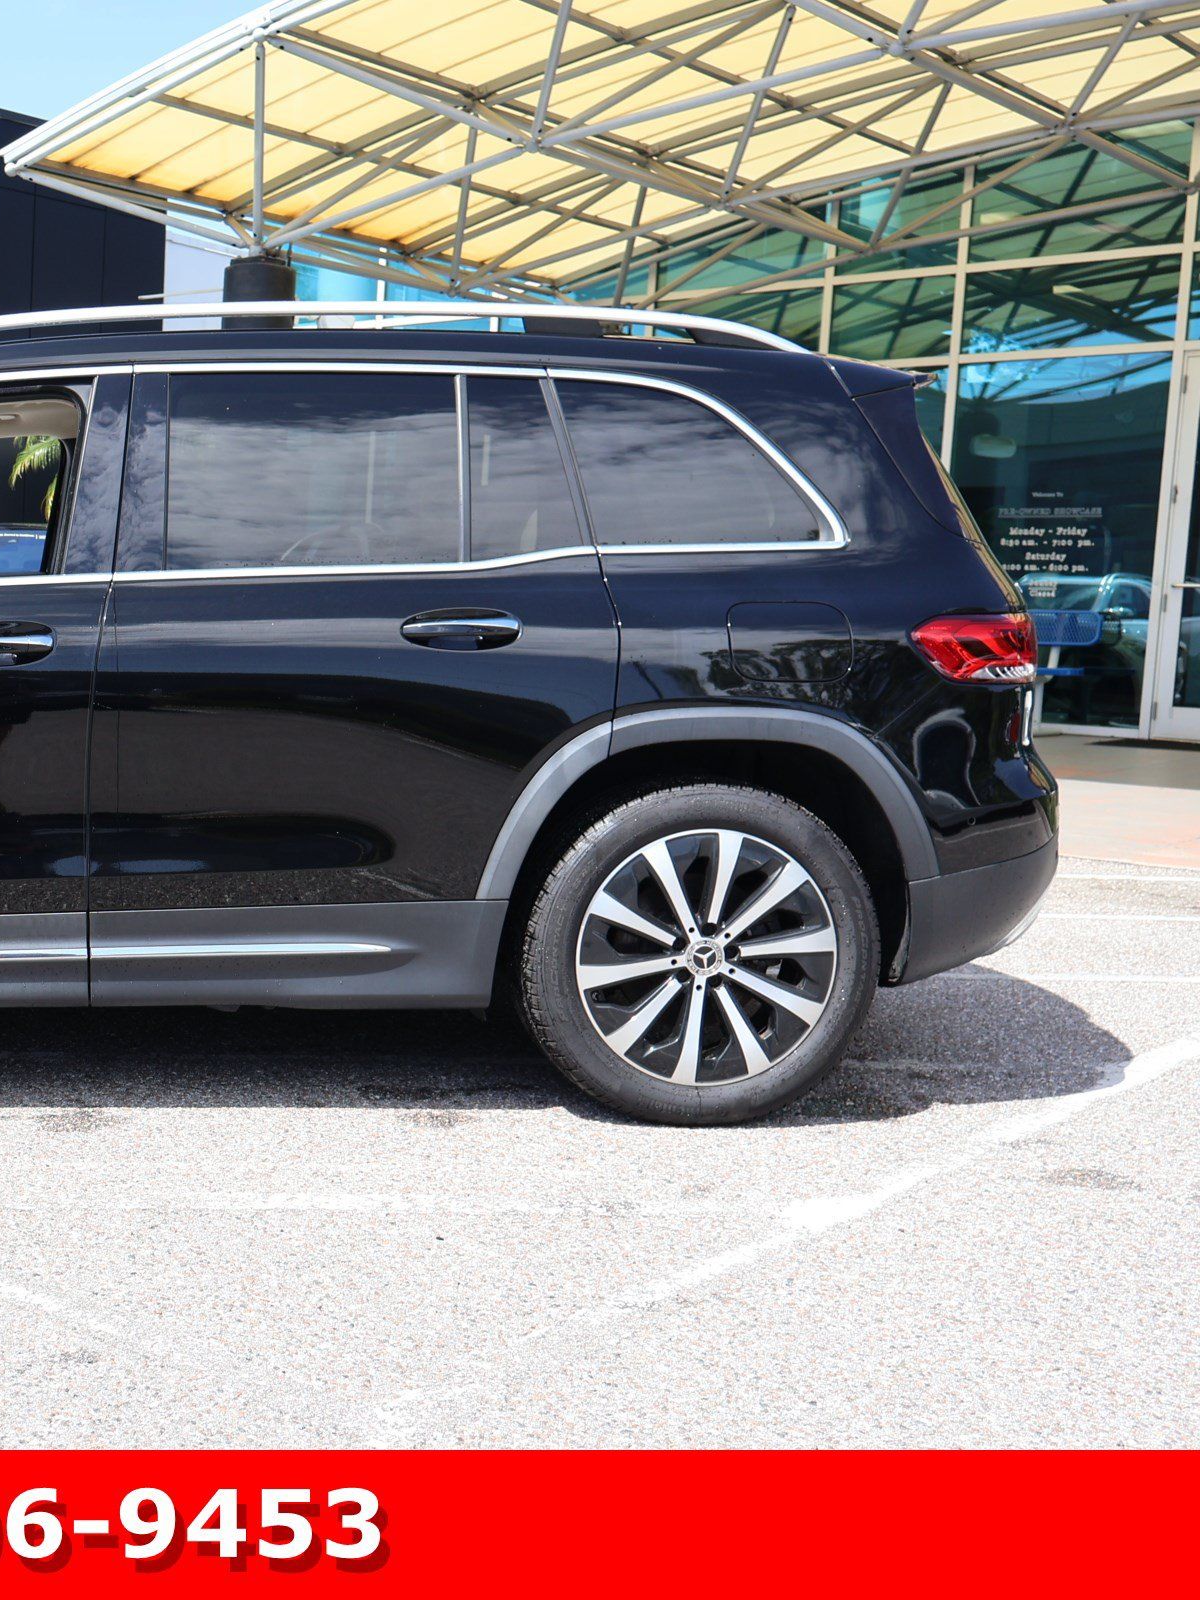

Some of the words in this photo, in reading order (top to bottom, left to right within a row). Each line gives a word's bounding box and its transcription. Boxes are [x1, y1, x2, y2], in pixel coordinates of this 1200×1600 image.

[1053, 507, 1103, 518] SHOWCASE
[1009, 527, 1045, 537] Monday
[1056, 527, 1088, 537] Friday
[1052, 539, 1073, 547] 7:00
[1077, 539, 1095, 548] pm.
[1025, 551, 1067, 562] Saturday
[1023, 564, 1040, 572] am.
[1048, 562, 1069, 572] 6:00
[1071, 564, 1089, 573] pm.
[1029, 589, 1056, 598] Closed
